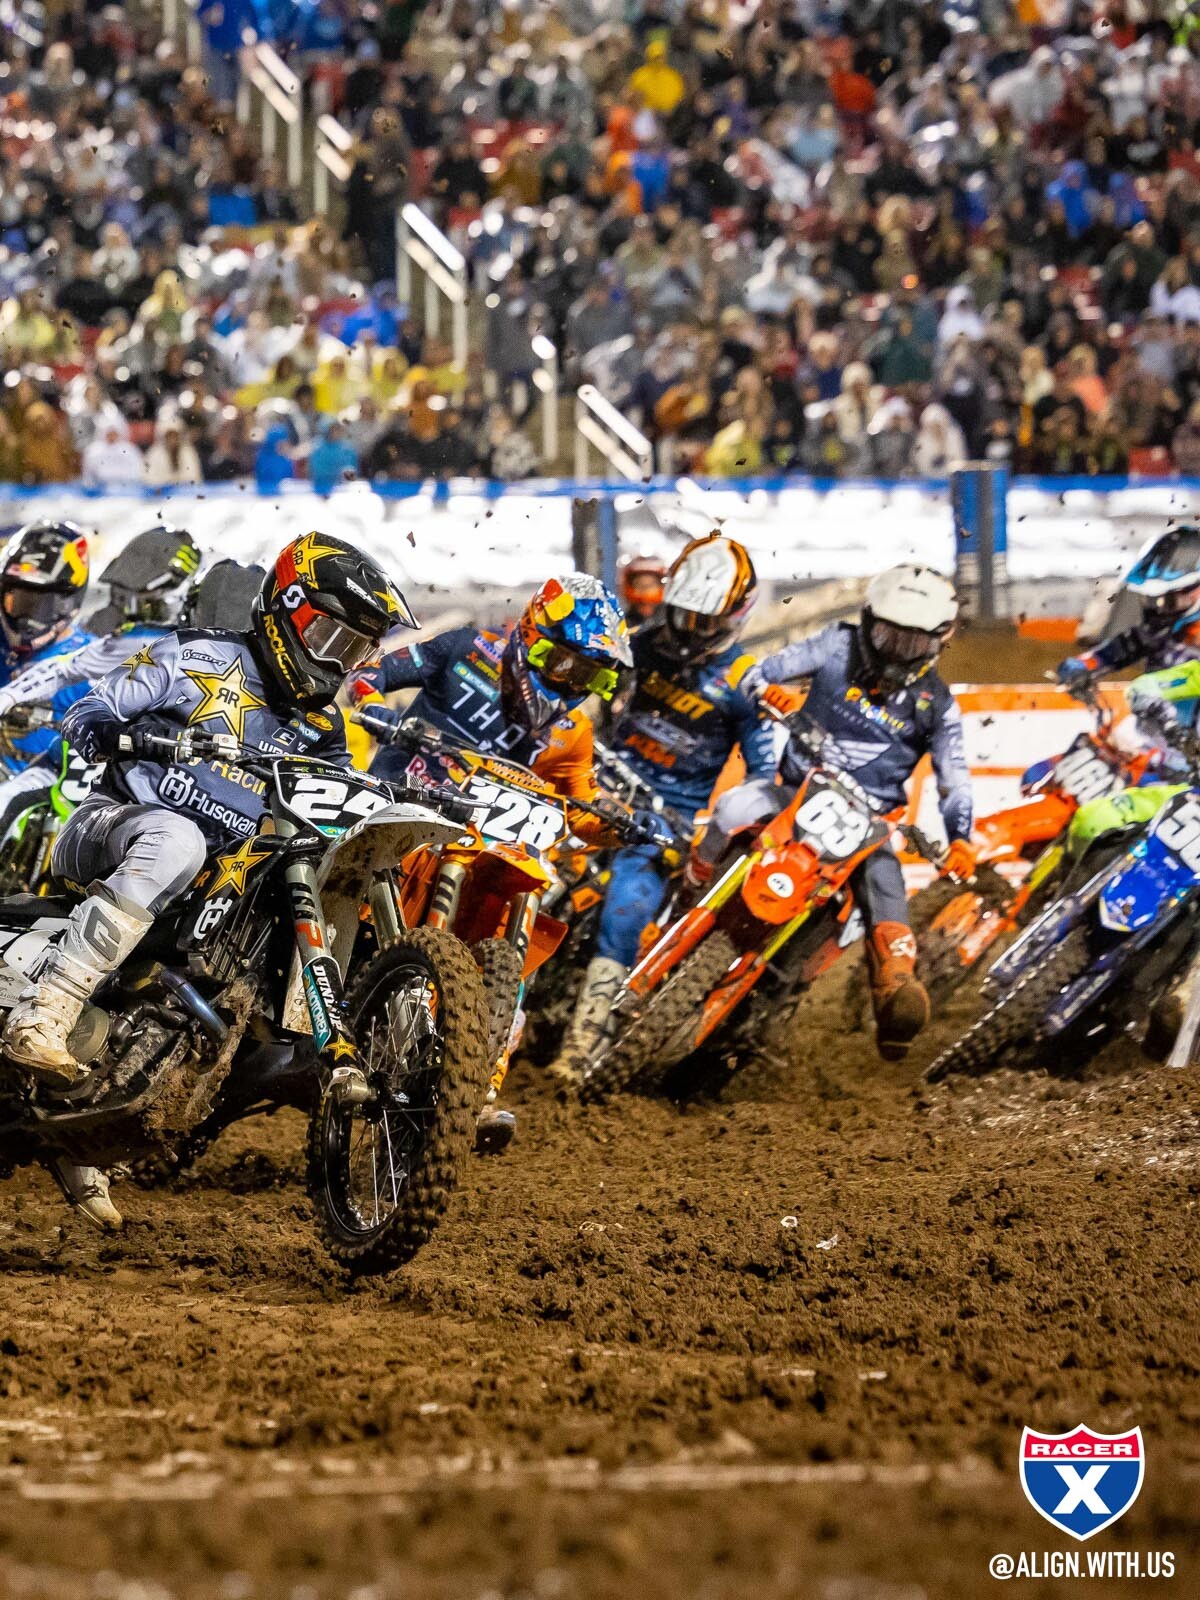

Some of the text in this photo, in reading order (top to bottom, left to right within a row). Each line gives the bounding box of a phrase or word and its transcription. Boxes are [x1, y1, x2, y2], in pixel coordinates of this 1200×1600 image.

[192, 650, 227, 667] SCOTT
[290, 779, 393, 820] 24
[467, 784, 564, 850] 128
[307, 987, 330, 1036] MOTOREX
